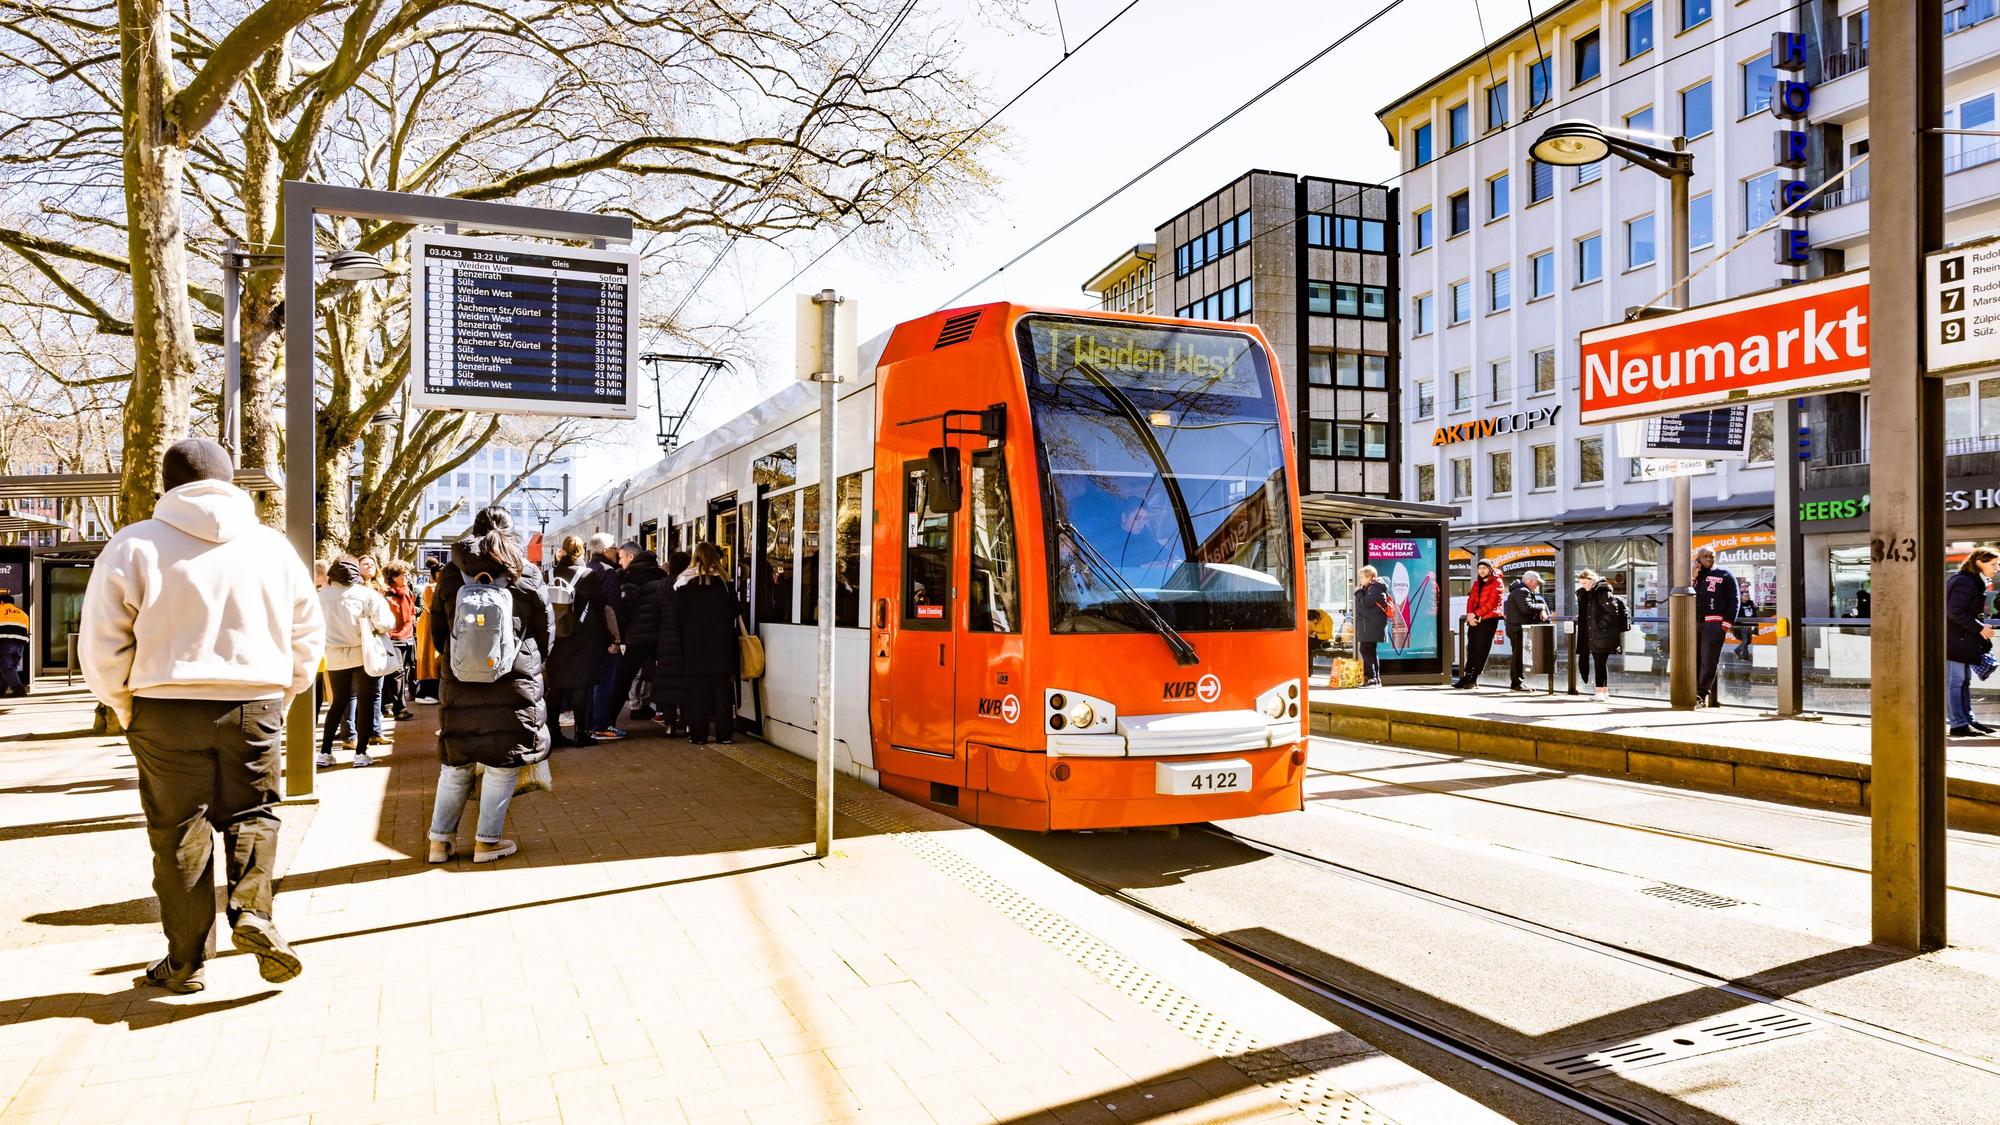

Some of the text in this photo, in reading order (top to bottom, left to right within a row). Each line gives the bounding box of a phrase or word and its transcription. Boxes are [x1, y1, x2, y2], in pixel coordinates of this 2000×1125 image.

[429, 248, 462, 258] 03.04.23
[473, 252, 493, 260] 13:22
[458, 261, 490, 269] Weiden
[1946, 261, 1956, 279] 1
[458, 270, 501, 280] Benzelrath
[458, 278, 474, 286] Sülz
[458, 286, 490, 295] Weiden
[492, 289, 513, 298] West
[458, 295, 474, 303] Sülz
[1945, 291, 1959, 310] 7
[457, 303, 497, 312] Aachener
[499, 307, 541, 317] Str./Gürtel
[458, 312, 490, 320] Weiden
[492, 314, 513, 322] West
[458, 320, 501, 330] Benzelrath
[1946, 322, 1960, 340] 9
[458, 328, 490, 337] Weiden
[457, 337, 497, 346] Aachener
[499, 339, 541, 350] Str./Gürtel
[458, 354, 490, 362] Weiden
[492, 356, 513, 364] West
[1075, 334, 1165, 374] Weiden
[1174, 342, 1234, 379] West
[1584, 305, 1868, 401] Neumarkt
[458, 362, 501, 372] Benzelrath
[458, 379, 490, 388] Weiden
[1680, 461, 1702, 469] Tickets
[1719, 549, 1776, 563] Aufklebe
[1870, 538, 1916, 562] 343
[1503, 561, 1535, 571] STUDENTEN
[1706, 576, 1723, 592] T
[1163, 681, 1196, 699] KVB
[978, 698, 1002, 715] KVB
[1191, 773, 1237, 789] 4122
